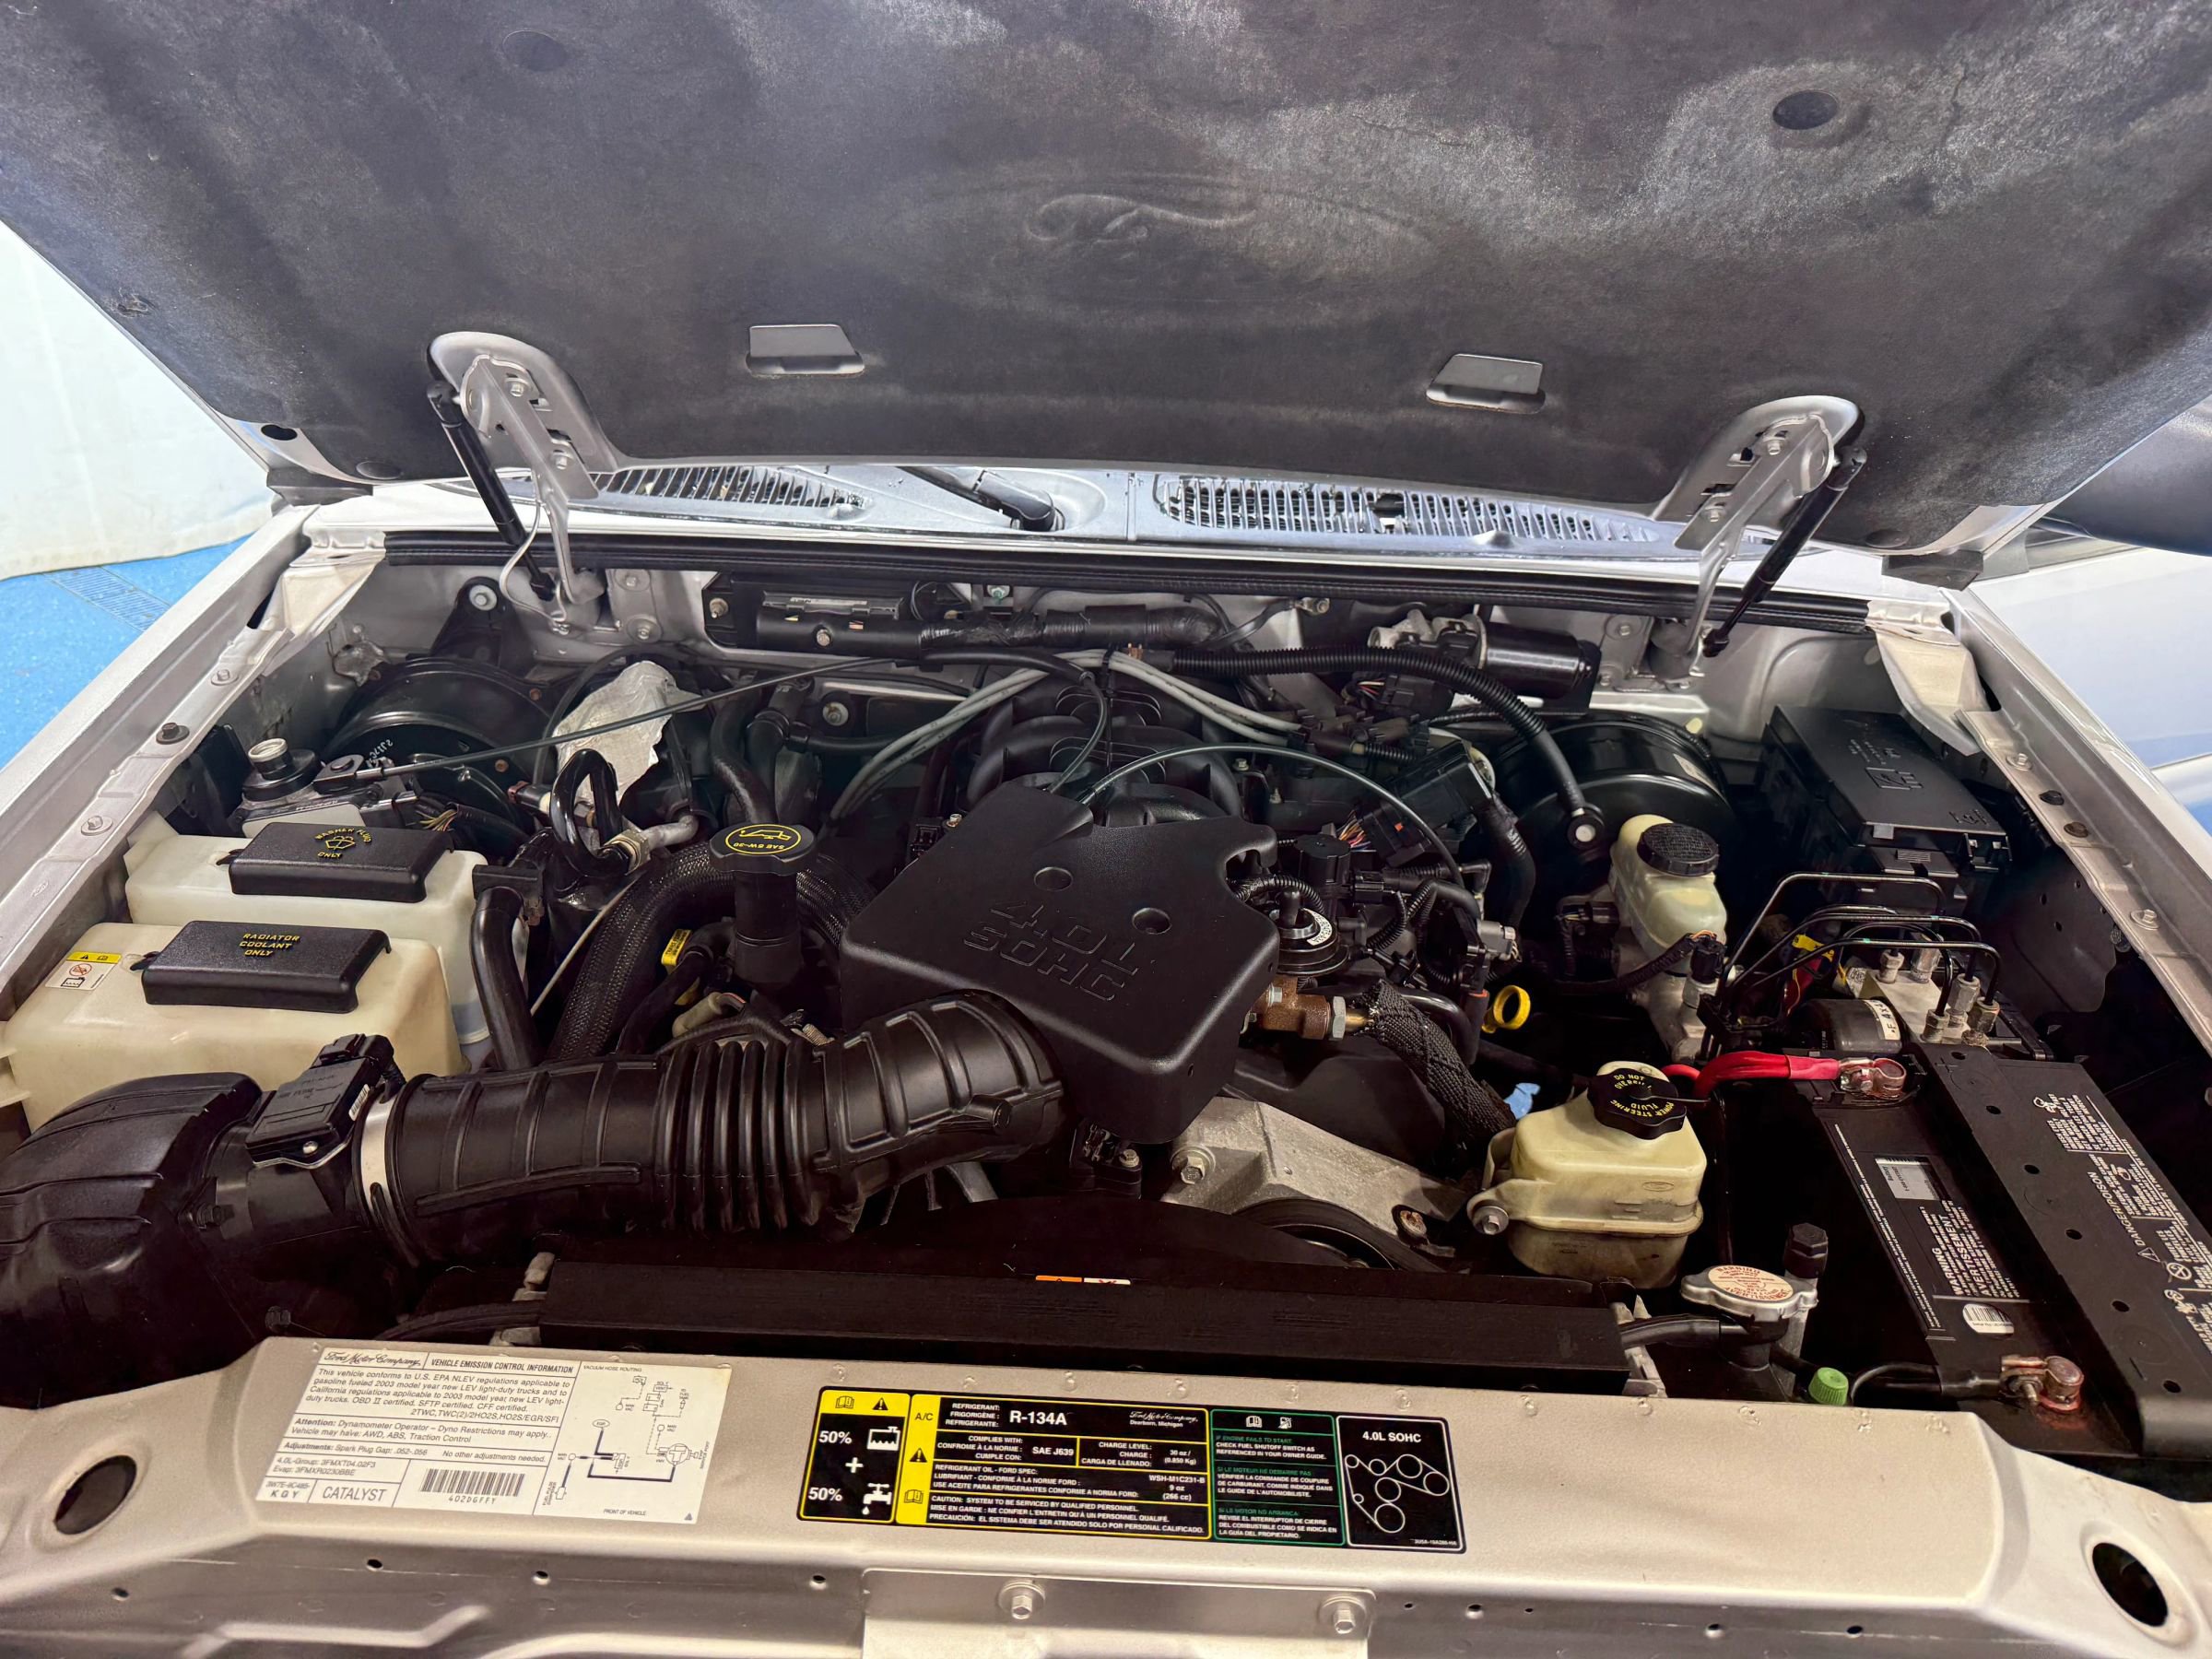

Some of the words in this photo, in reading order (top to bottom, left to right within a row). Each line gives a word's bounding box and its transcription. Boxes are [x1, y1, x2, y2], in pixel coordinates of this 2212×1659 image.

[243, 933, 300, 942] RADIATOR
[963, 926, 1125, 1001] SOHC
[2087, 1172, 2146, 1246] DANGER/POISON
[1938, 1215, 1992, 1297] AVERTISSEMENT
[1932, 1248, 1963, 1295] WARNING
[431, 1359, 460, 1368] VEHICLE
[460, 1360, 492, 1370] EMISSION
[494, 1362, 525, 1371] CONTROL
[527, 1364, 573, 1373] INFORMATION
[313, 1378, 347, 1386] gasoline
[479, 1386, 514, 1394] light-duty
[516, 1387, 540, 1395] trucks
[433, 1373, 450, 1382] EPA
[476, 1377, 519, 1386] regulations
[520, 1379, 560, 1388] applicable
[348, 1388, 391, 1396] regulations
[393, 1390, 431, 1398] applicable
[526, 1396, 544, 1405] LEV
[545, 1397, 564, 1406] light-
[441, 1401, 475, 1409] certified.
[951, 1403, 1001, 1411] REFRIGERANT:
[914, 1412, 934, 1421] A/C
[949, 1410, 995, 1419] FRIGORIGÈNE
[1009, 1410, 1067, 1426] R-134A
[295, 1418, 336, 1427] Attention:
[337, 1419, 393, 1430] Dynamometer
[394, 1423, 429, 1432] Operator
[437, 1425, 458, 1434] Dyno
[460, 1427, 506, 1436] Restrictions
[507, 1430, 524, 1438] may
[946, 1419, 999, 1428] REFRIGERANTE:
[291, 1427, 319, 1435] Vehicle
[321, 1429, 337, 1437] may
[339, 1429, 361, 1437] have:
[362, 1430, 384, 1439] AWD,
[409, 1432, 441, 1441] Traction
[818, 1430, 853, 1444] 50%
[968, 1435, 1003, 1443] COMPLIES
[1362, 1430, 1386, 1441] 4.0L
[1388, 1432, 1421, 1443] SOHC
[284, 1441, 334, 1451] Adjustments:
[335, 1444, 356, 1453] Spark
[358, 1445, 374, 1454] Plug
[994, 1444, 1018, 1453] NORME
[1032, 1446, 1052, 1455] SAE
[1053, 1447, 1075, 1456] J639
[1128, 1442, 1152, 1451] LEVEL:
[474, 1453, 516, 1462] adjustments
[518, 1454, 546, 1463] needed.
[935, 1464, 981, 1473] REFRIGERANT
[1018, 1467, 1038, 1476] SPEC:
[1148, 1475, 1206, 1484] WSH-M1C231-B
[323, 1486, 387, 1501] CATALYST
[807, 1487, 843, 1502] 50%
[1180, 1493, 1192, 1502] cc)
[931, 1495, 964, 1503] CAUTION:
[967, 1497, 994, 1505] SYSTEM
[1016, 1500, 1049, 1508] SERVICED
